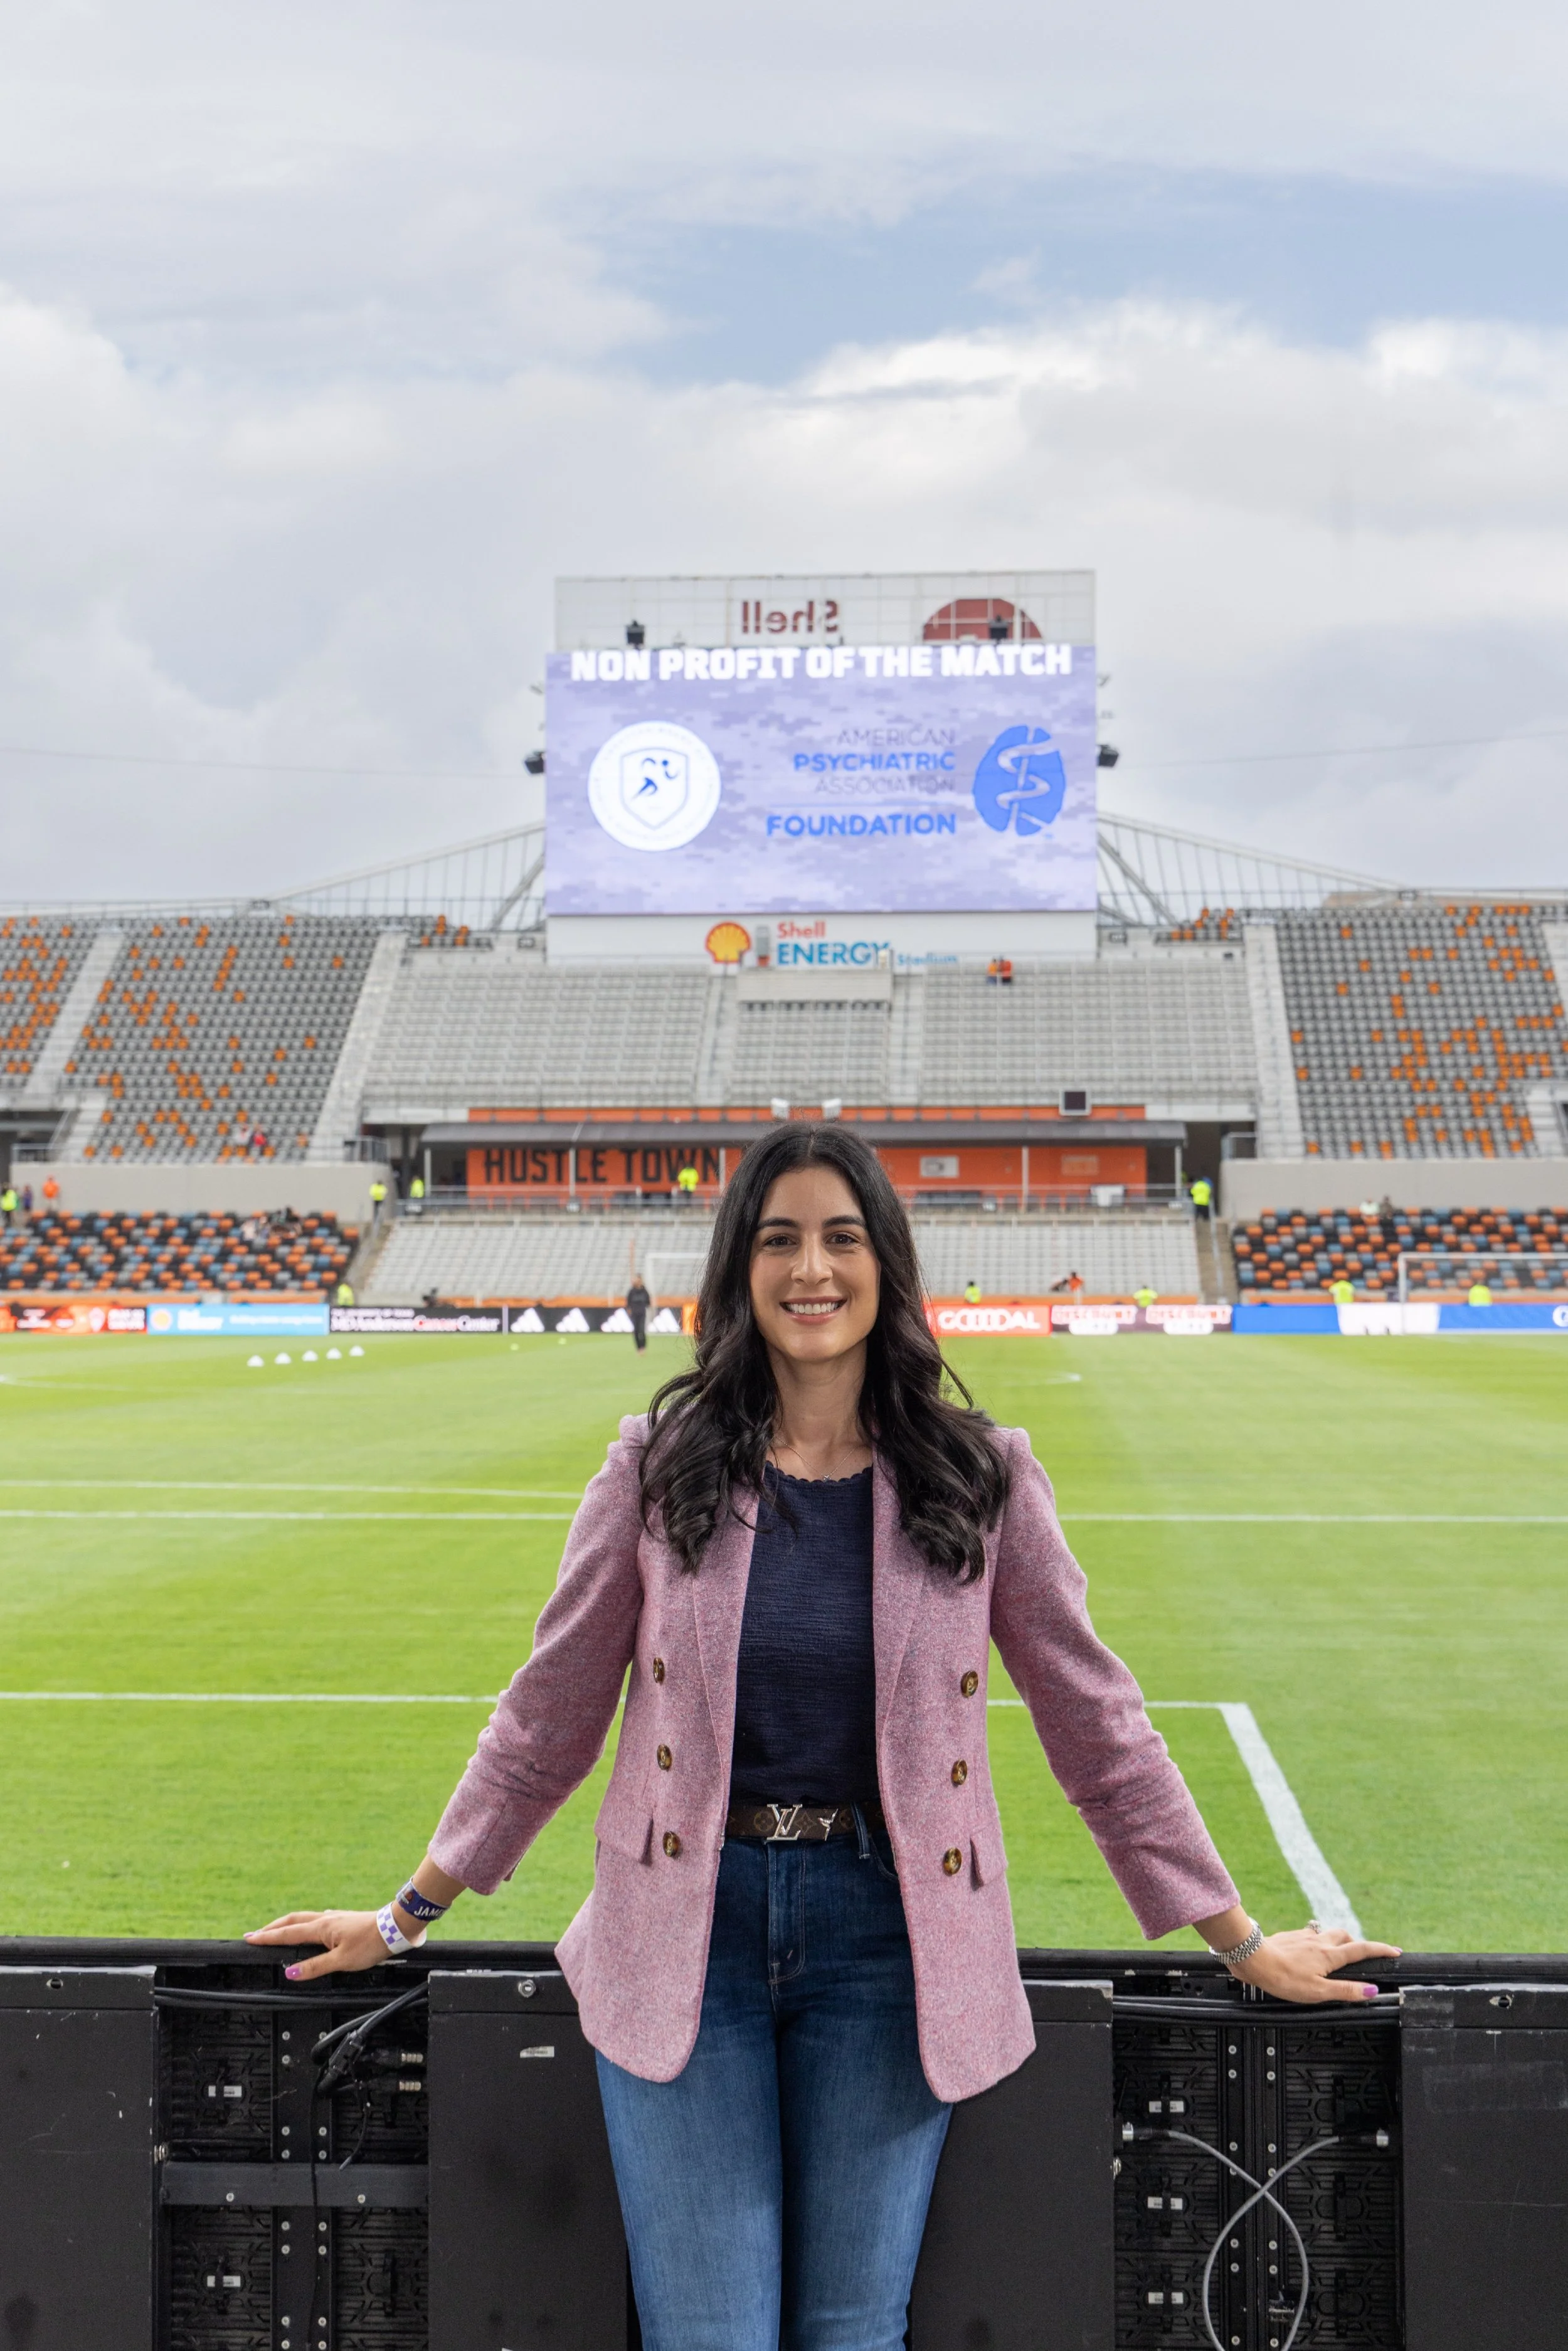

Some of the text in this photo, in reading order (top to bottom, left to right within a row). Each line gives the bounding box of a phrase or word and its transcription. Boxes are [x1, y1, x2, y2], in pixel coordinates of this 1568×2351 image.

[570, 643, 1072, 681] NON PROFIT OF THE MATCH
[837, 729, 955, 747] AMERICAN
[793, 751, 956, 772] PSYCHIATRIC
[815, 775, 955, 795] ASSOCIATION
[766, 814, 956, 837] FOUNDATION
[777, 921, 826, 940] Shell
[777, 942, 889, 966] ENERGY
[484, 1148, 607, 1183] HUSTLE
[621, 1147, 721, 1182] TOWN
